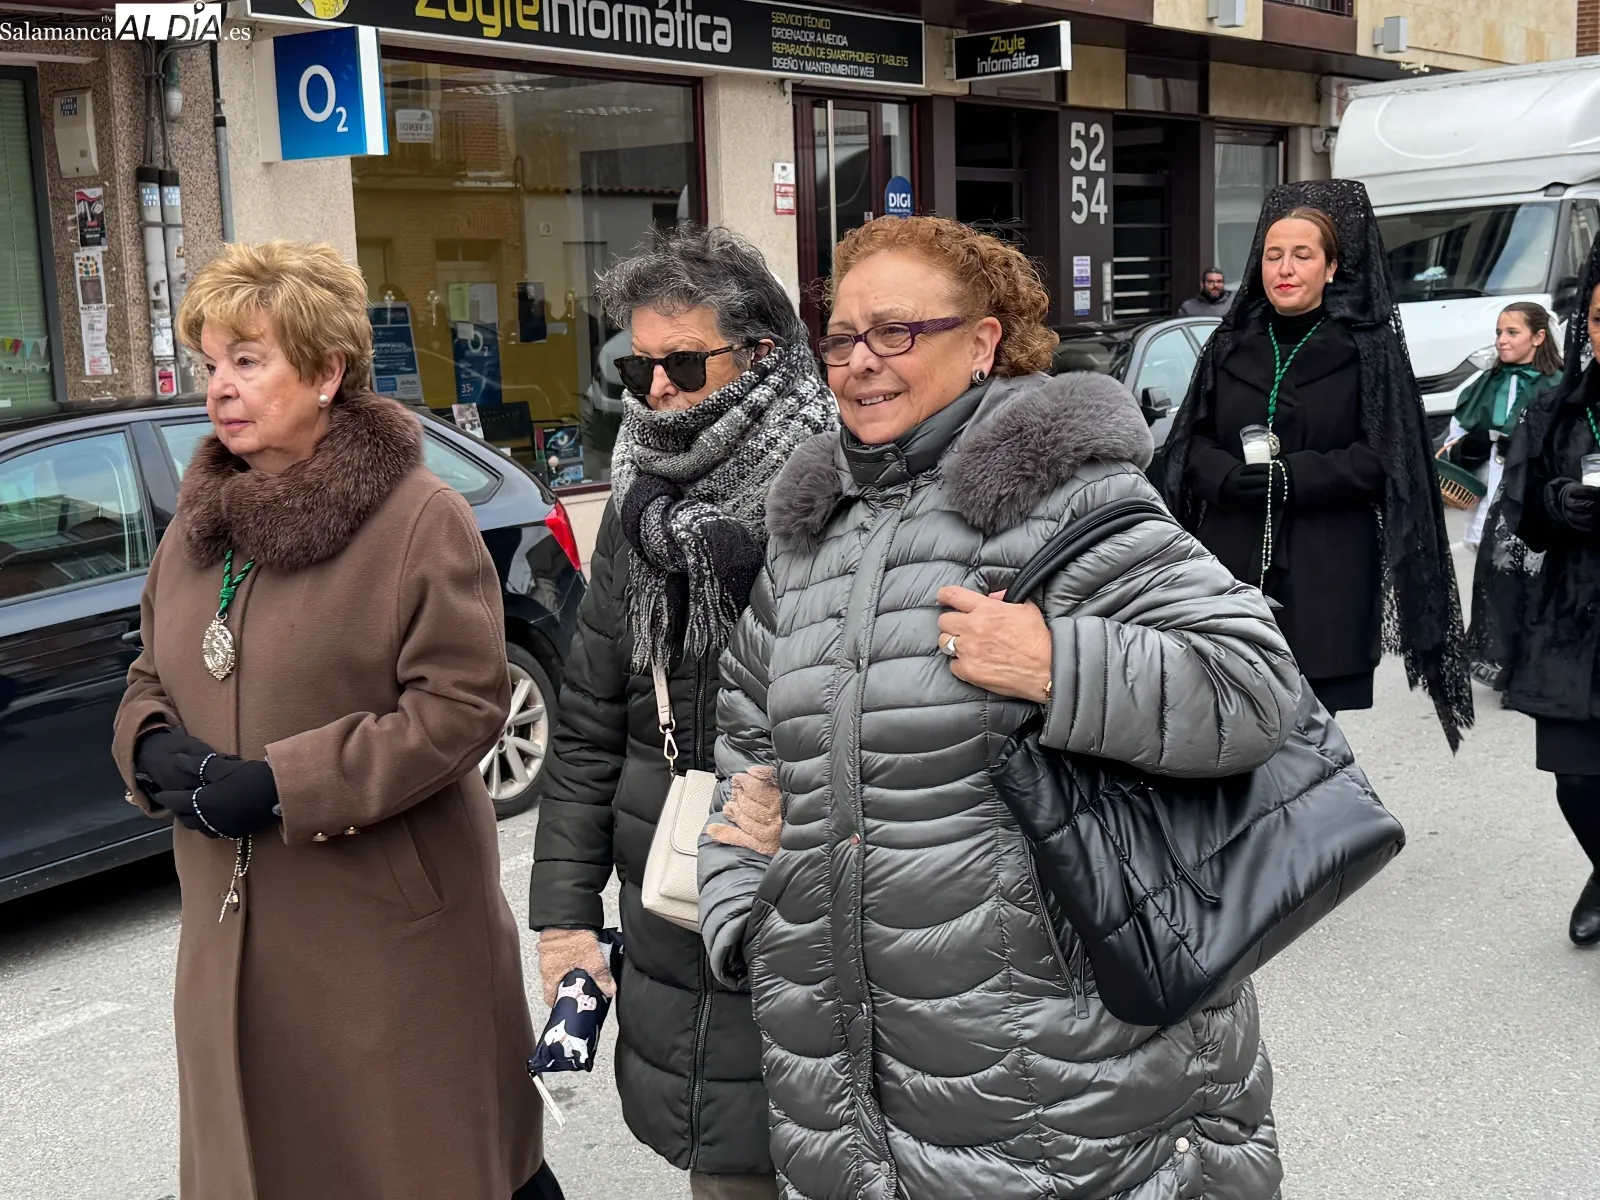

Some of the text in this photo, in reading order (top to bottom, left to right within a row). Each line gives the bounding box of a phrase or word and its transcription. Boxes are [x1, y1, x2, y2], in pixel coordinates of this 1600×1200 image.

[771, 11, 831, 30] SERVICIO TÉCNICO
[771, 26, 849, 47] ORDENADOR A MEDIDA
[990, 34, 1026, 55] Zbyte
[772, 42, 909, 67] REPARACIÓN DE SMARTPHONES Y TABLETS
[977, 51, 1040, 74] informática
[772, 57, 875, 78] DISEÑO Y MANTENIMIENTO WEB
[1069, 121, 1107, 172] 52
[888, 192, 911, 208] DIGI
[1070, 176, 1109, 225] 54
